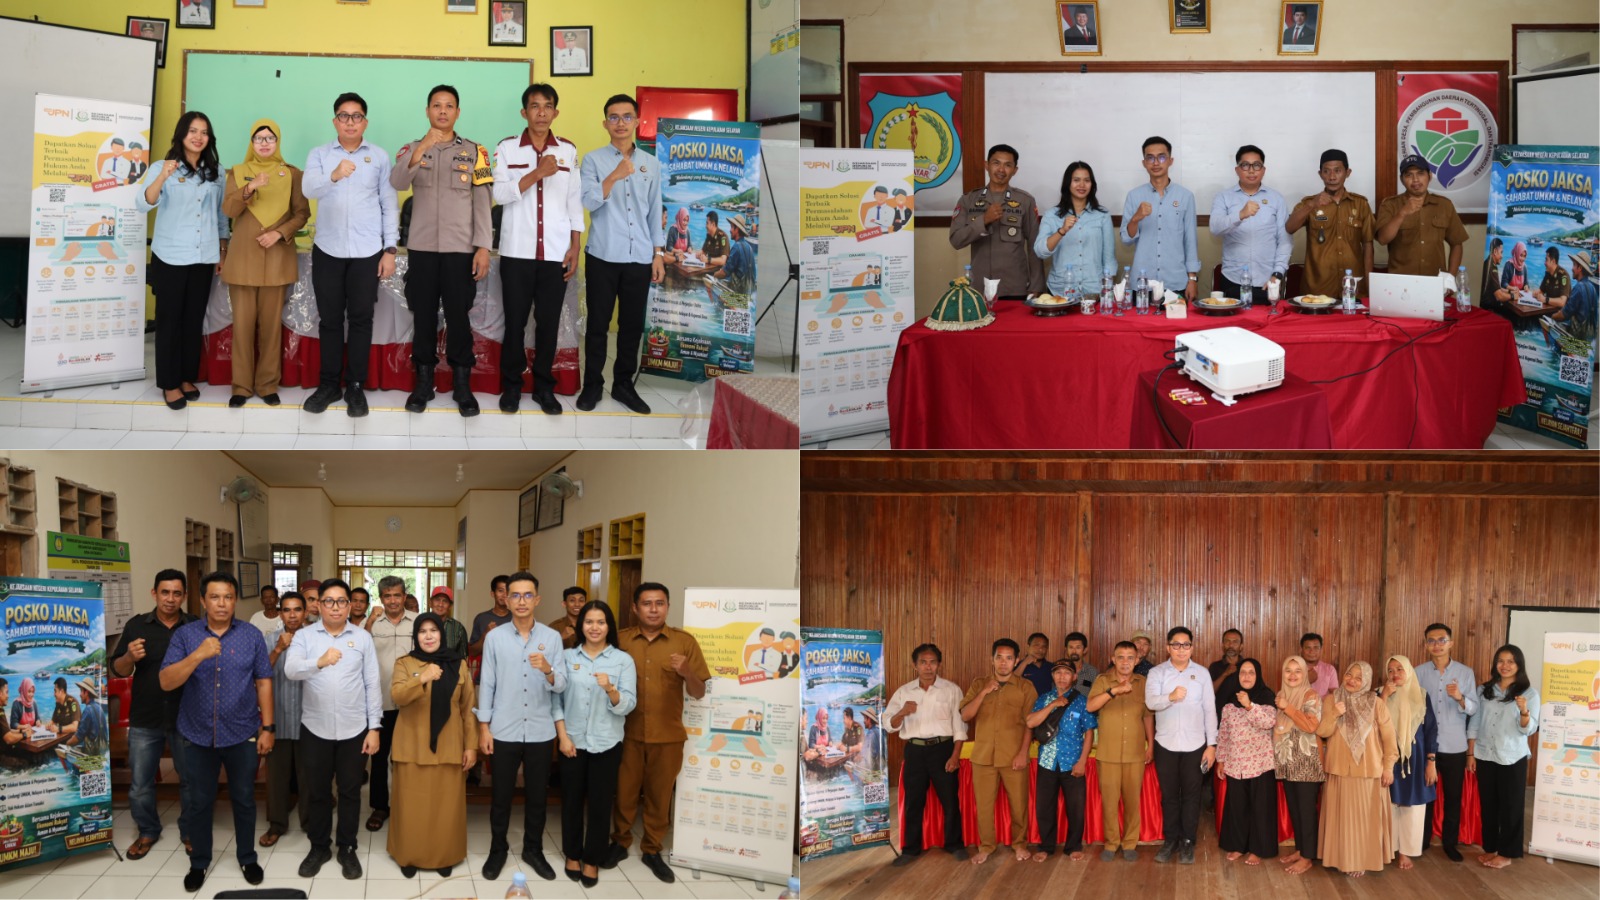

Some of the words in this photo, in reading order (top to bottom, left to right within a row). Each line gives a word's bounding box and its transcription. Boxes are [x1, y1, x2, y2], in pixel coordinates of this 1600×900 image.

[1406, 95, 1440, 124] PEMBANGUNAN
[1474, 138, 1493, 176] TRANSMIGRASI
[670, 142, 707, 160] POSKO
[709, 143, 744, 165] JAKSA
[669, 162, 694, 172] SAHABAT
[696, 162, 712, 170] UMKM
[719, 163, 744, 177] NELAYAN
[1506, 170, 1549, 190] POSKO
[1551, 170, 1592, 196] JAKSA
[1505, 192, 1534, 203] SAHABAT
[1534, 192, 1554, 200] UMKM
[1562, 193, 1592, 210] NELAYAN
[859, 230, 880, 239] GRATIS
[648, 358, 663, 366] UMKM
[664, 360, 679, 369] MAJU!
[5, 603, 49, 626] POSKO
[52, 604, 89, 626] JAKSA
[6, 625, 36, 639] SAHABAT
[37, 625, 57, 634] UMKM
[64, 627, 89, 638] NELAYAN
[806, 648, 840, 666] POSKO
[842, 648, 872, 666] JAKSA
[54, 818, 68, 826] Rakyat
[20, 846, 36, 857] MAJU!
